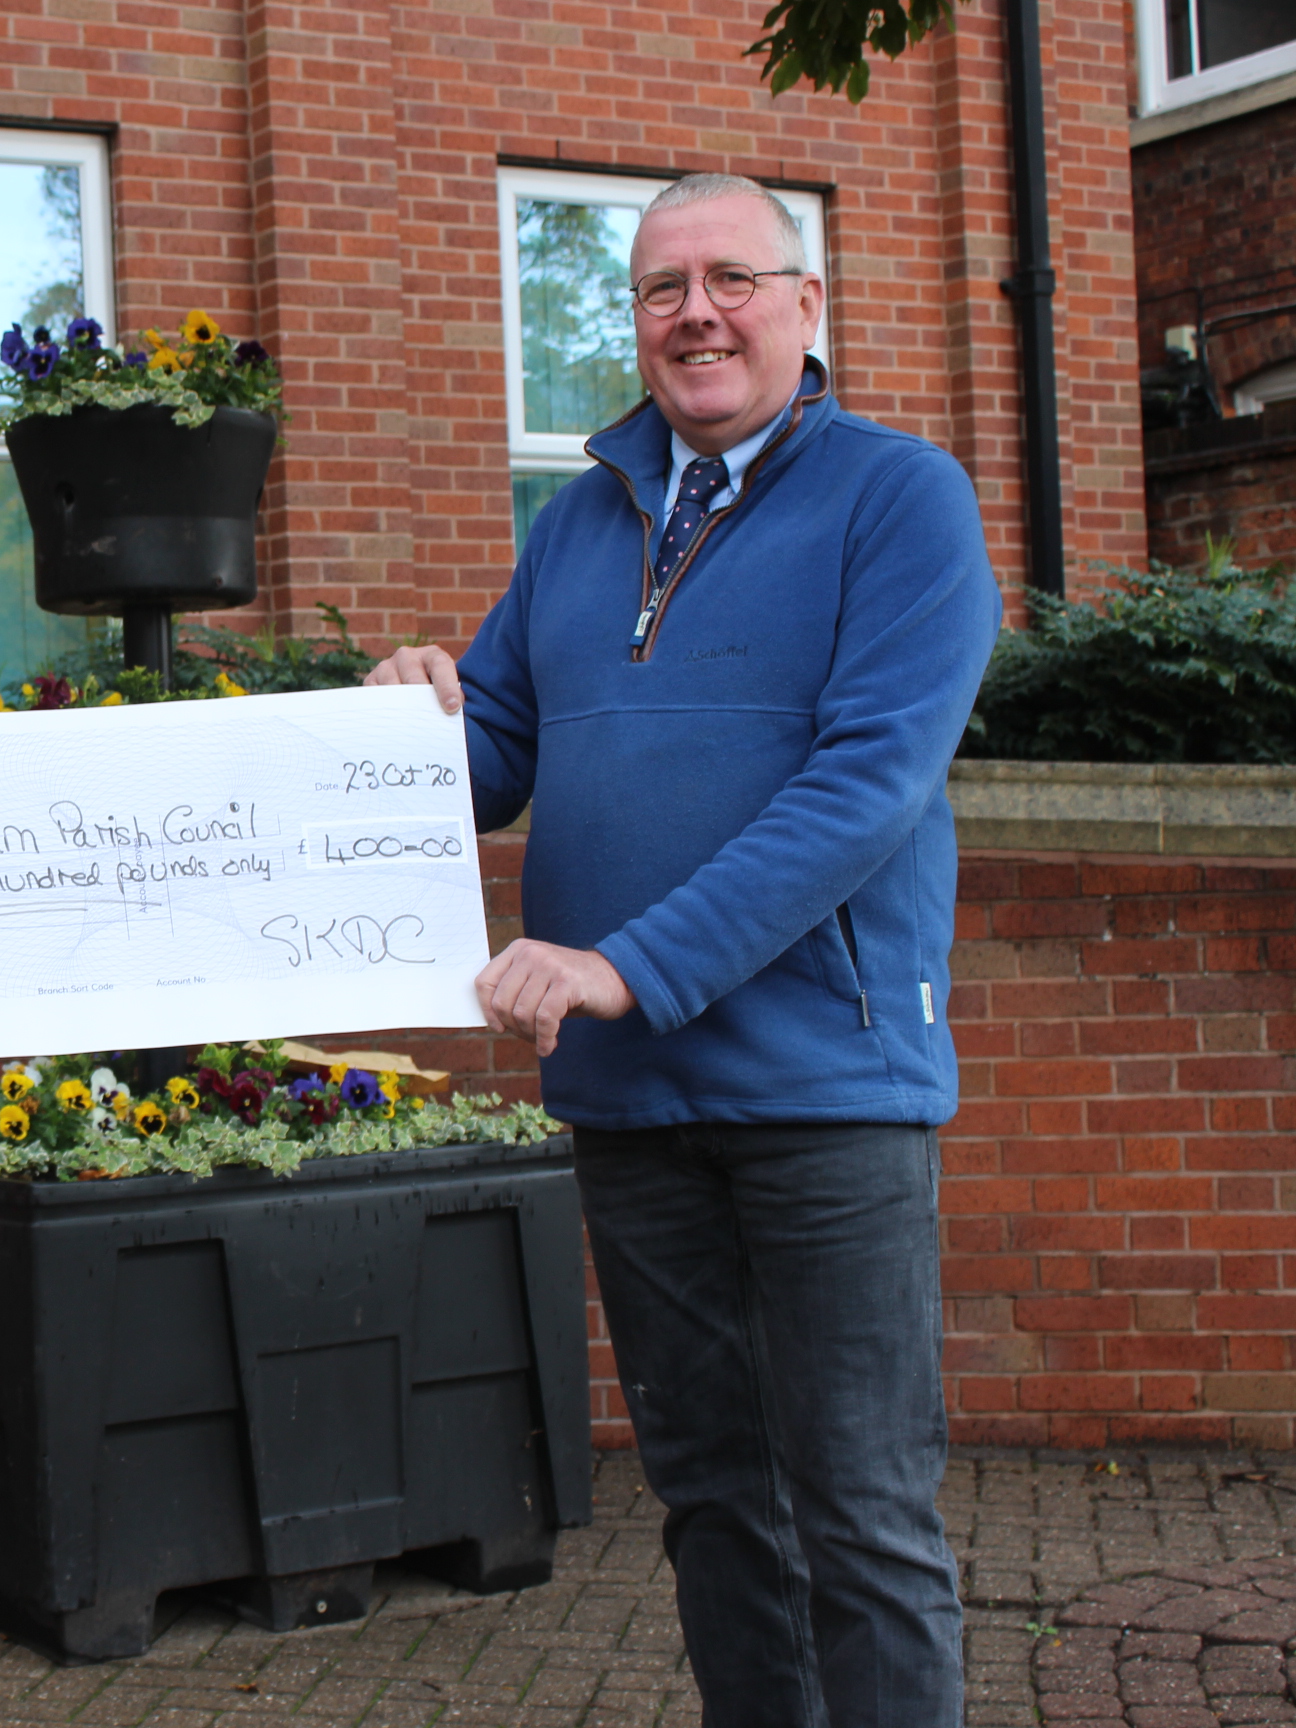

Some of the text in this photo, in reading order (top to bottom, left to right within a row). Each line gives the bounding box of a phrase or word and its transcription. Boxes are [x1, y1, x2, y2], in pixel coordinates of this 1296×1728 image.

[314, 782, 339, 792] Date
[343, 760, 457, 794] 23 Oct '20
[49, 800, 153, 849] Parish
[162, 802, 257, 845] Council
[116, 854, 209, 895] pounds
[221, 853, 271, 881] only
[261, 914, 436, 968] SKDC
[37, 982, 114, 995] Branch Sort Code
[156, 975, 206, 987] Account No
